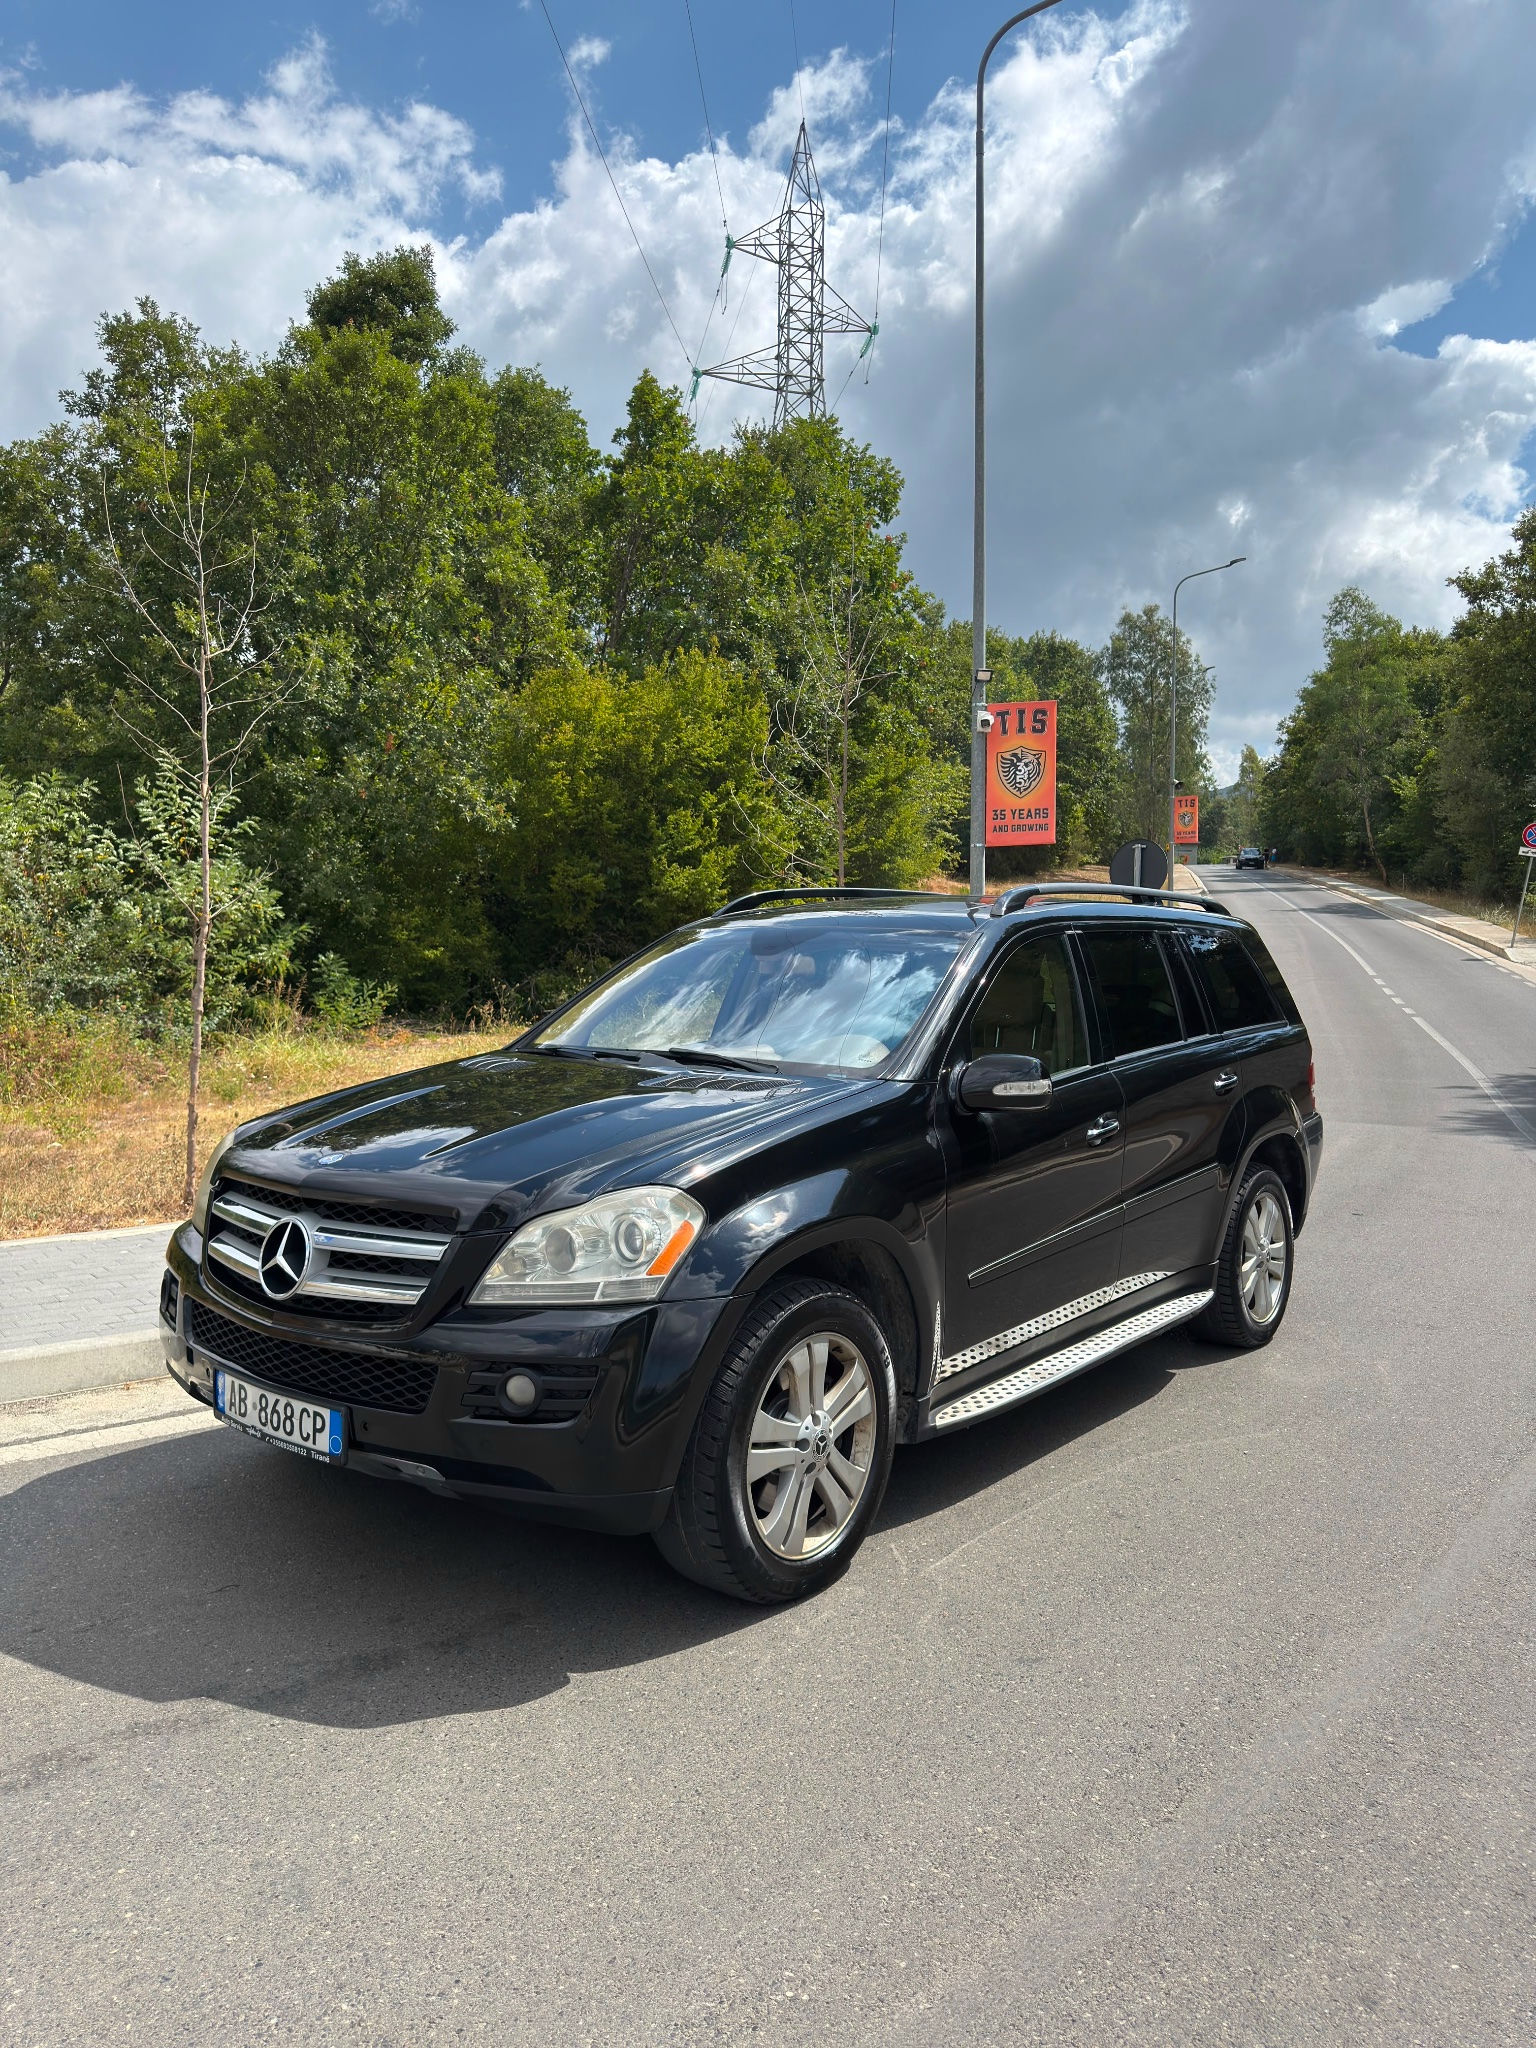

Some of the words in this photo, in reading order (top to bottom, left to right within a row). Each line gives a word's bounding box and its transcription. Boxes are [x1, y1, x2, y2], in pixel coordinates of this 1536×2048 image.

[995, 708, 1049, 736] TIS
[1178, 799, 1196, 808] TIS
[992, 809, 1007, 821] 35
[1010, 808, 1049, 820] YEARS
[992, 824, 1009, 833] AND
[1011, 823, 1049, 833] GROWING
[228, 1379, 248, 1418] AB
